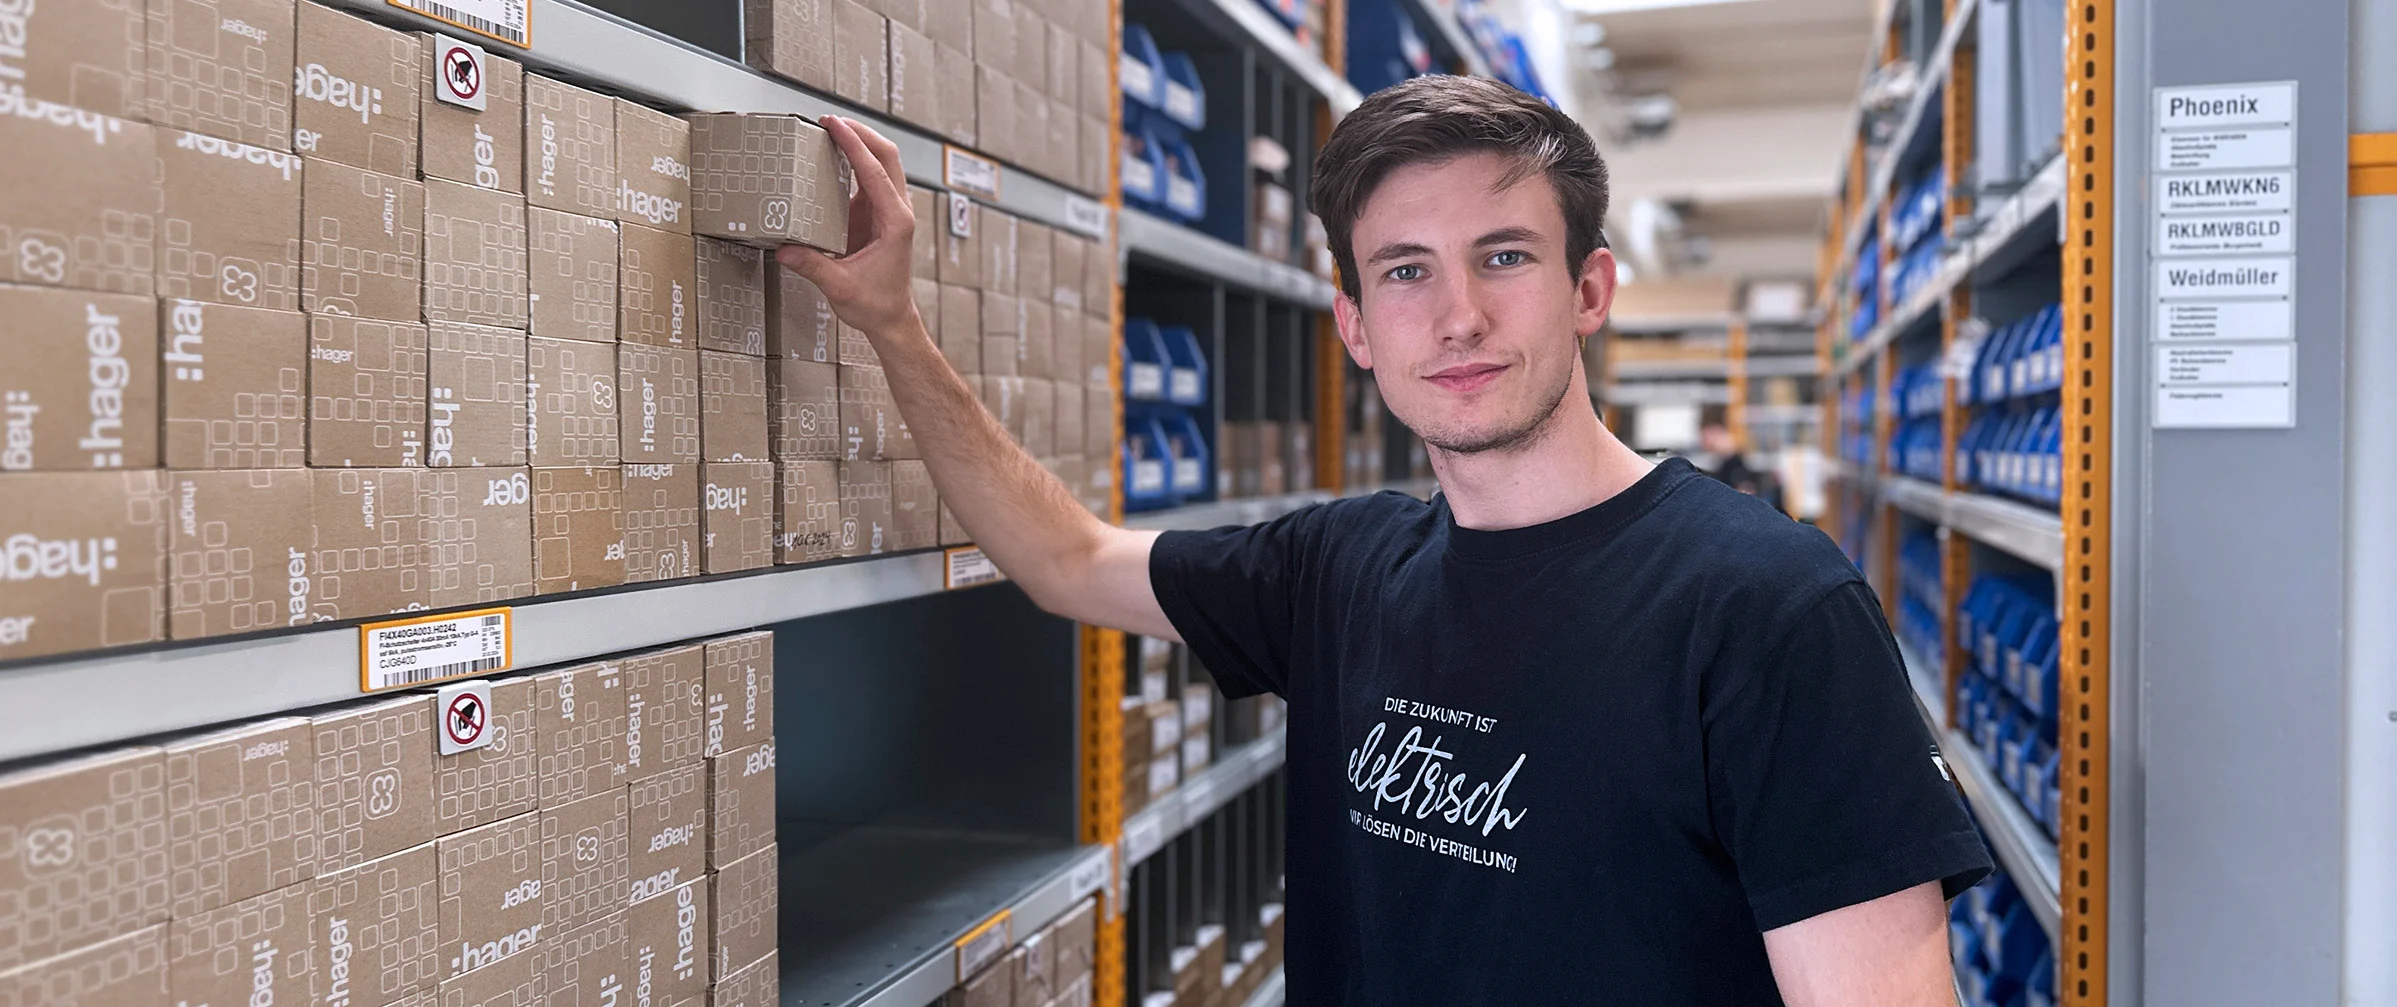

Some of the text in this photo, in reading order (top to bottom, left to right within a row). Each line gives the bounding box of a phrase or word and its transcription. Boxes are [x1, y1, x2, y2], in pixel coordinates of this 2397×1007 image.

[2169, 94, 2259, 117] Phoenix
[537, 113, 560, 197] :hager
[616, 178, 682, 224] :hager
[2168, 177, 2280, 198] RKLMWKN6
[2168, 220, 2281, 239] RKLMWBGLD
[2169, 267, 2279, 287] Weidmüller
[79, 303, 130, 468] :hager
[640, 377, 658, 452] :hager
[0, 533, 118, 586] :hag
[627, 693, 646, 768] :hager
[1384, 697, 1498, 733] DIE ZUKUNFT IST
[1348, 721, 1528, 837] elektrisch
[1362, 813, 1401, 841] LÖSEN
[1403, 828, 1428, 848] DIE
[1428, 835, 1518, 874] VERTEILUNG!
